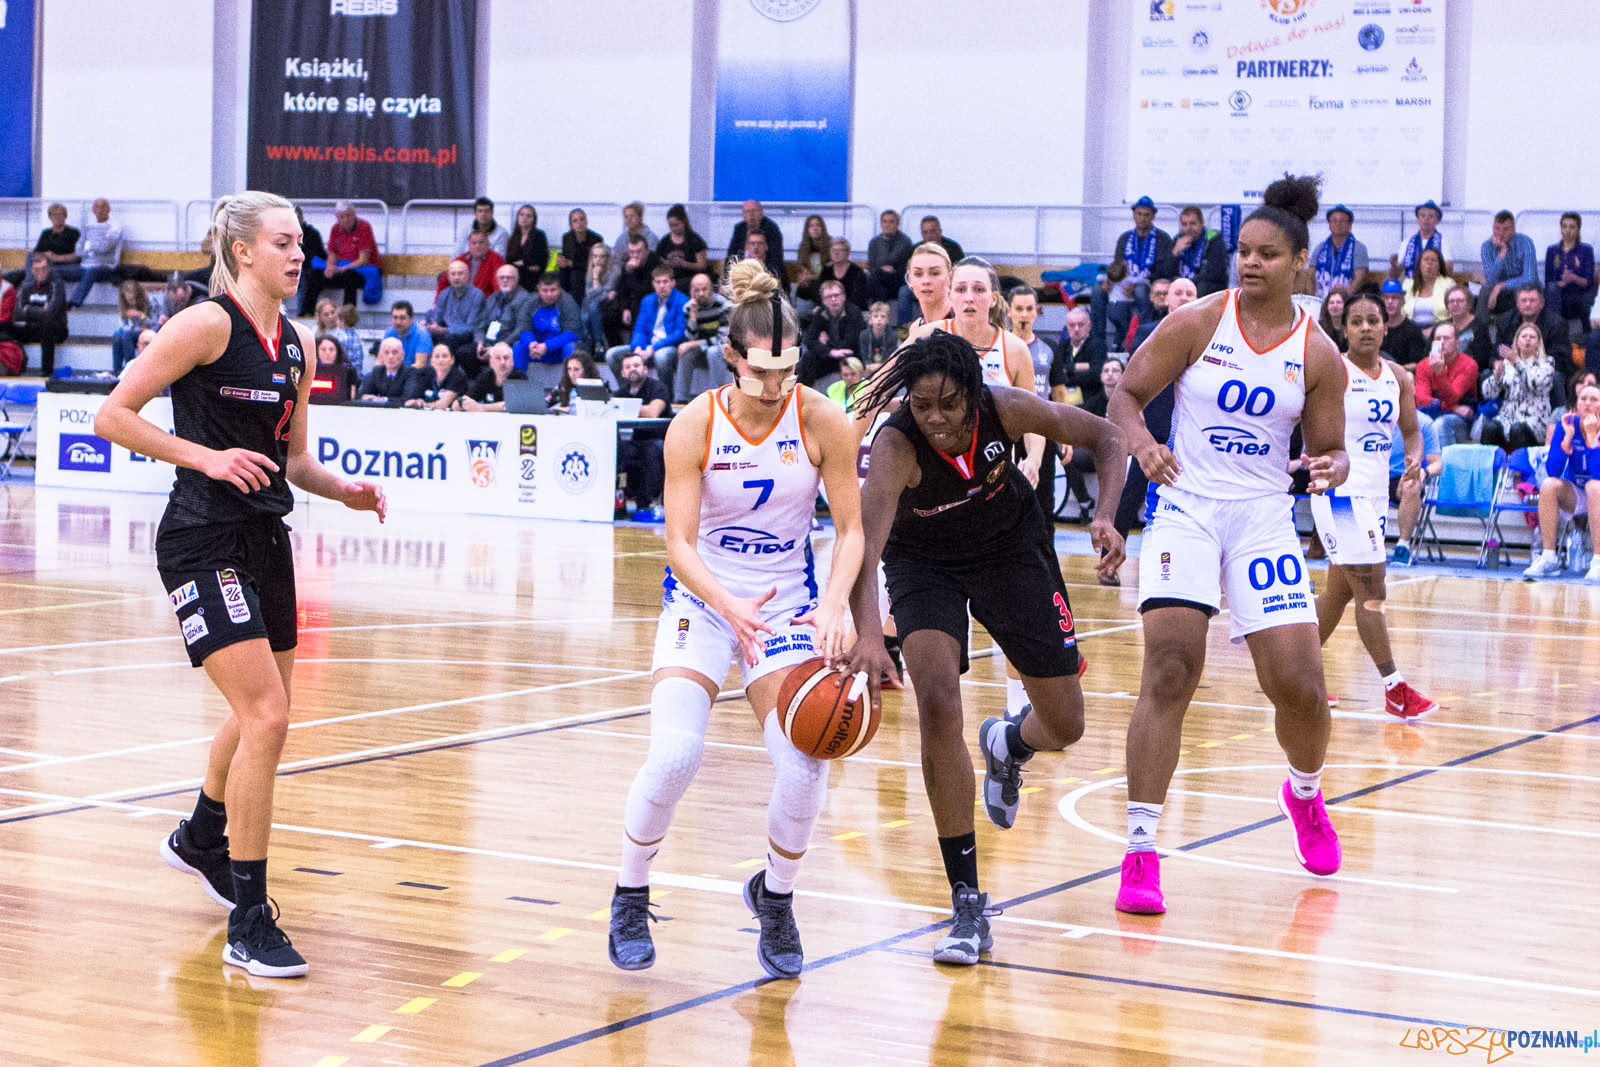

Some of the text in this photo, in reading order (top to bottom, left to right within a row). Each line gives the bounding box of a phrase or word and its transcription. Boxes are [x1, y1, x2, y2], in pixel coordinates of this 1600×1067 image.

[331, 0, 399, 16] REBIS
[285, 57, 369, 83] Książki,
[1236, 59, 1334, 78] PARTNERZY:
[284, 92, 442, 118] które się czyta
[1395, 97, 1432, 107] MARSH
[266, 144, 457, 168] www.rebis.com.pl
[1217, 379, 1276, 417] 00
[1367, 398, 1394, 423] 32
[70, 449, 105, 465] Enea
[1209, 433, 1271, 456] Enea
[318, 437, 447, 480] Poznań
[743, 479, 775, 511] 7
[1248, 554, 1302, 591] 00
[1053, 591, 1073, 632] 3
